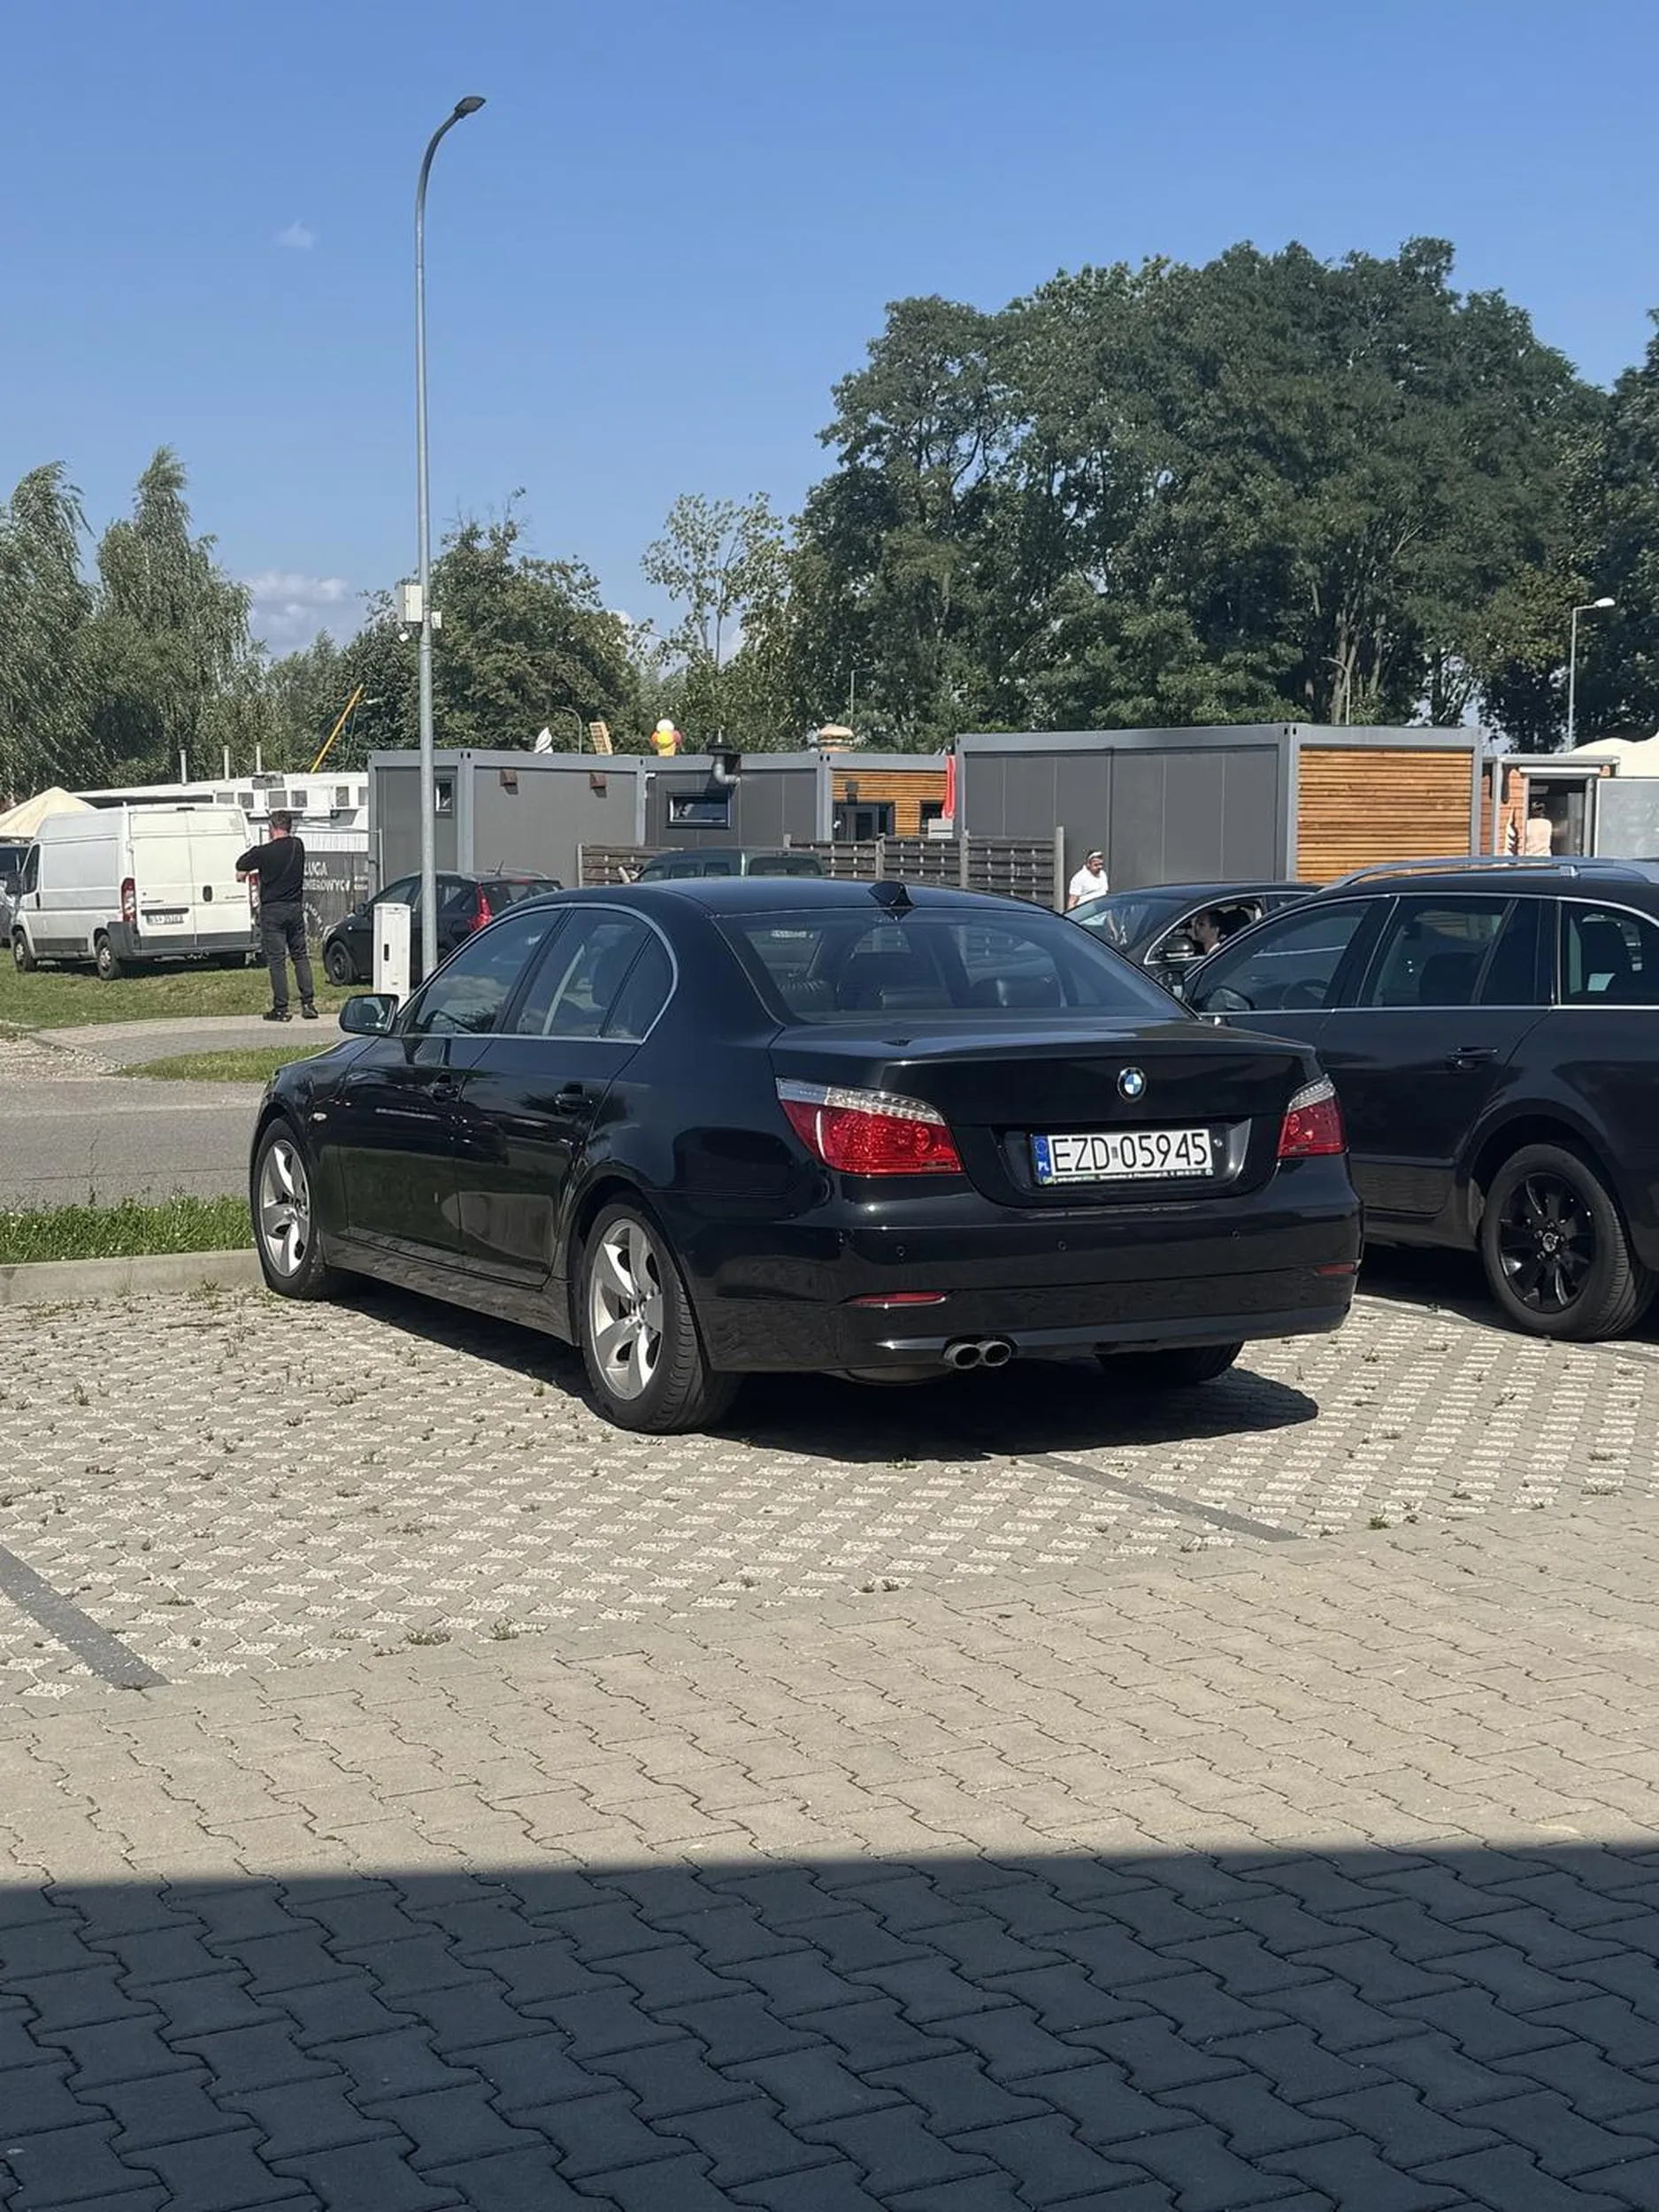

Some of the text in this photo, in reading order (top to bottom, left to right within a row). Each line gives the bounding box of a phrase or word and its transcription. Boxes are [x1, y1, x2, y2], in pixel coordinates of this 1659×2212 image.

[1051, 1133, 1208, 1172] EZD 05945
[1037, 1161, 1050, 1171] PL
